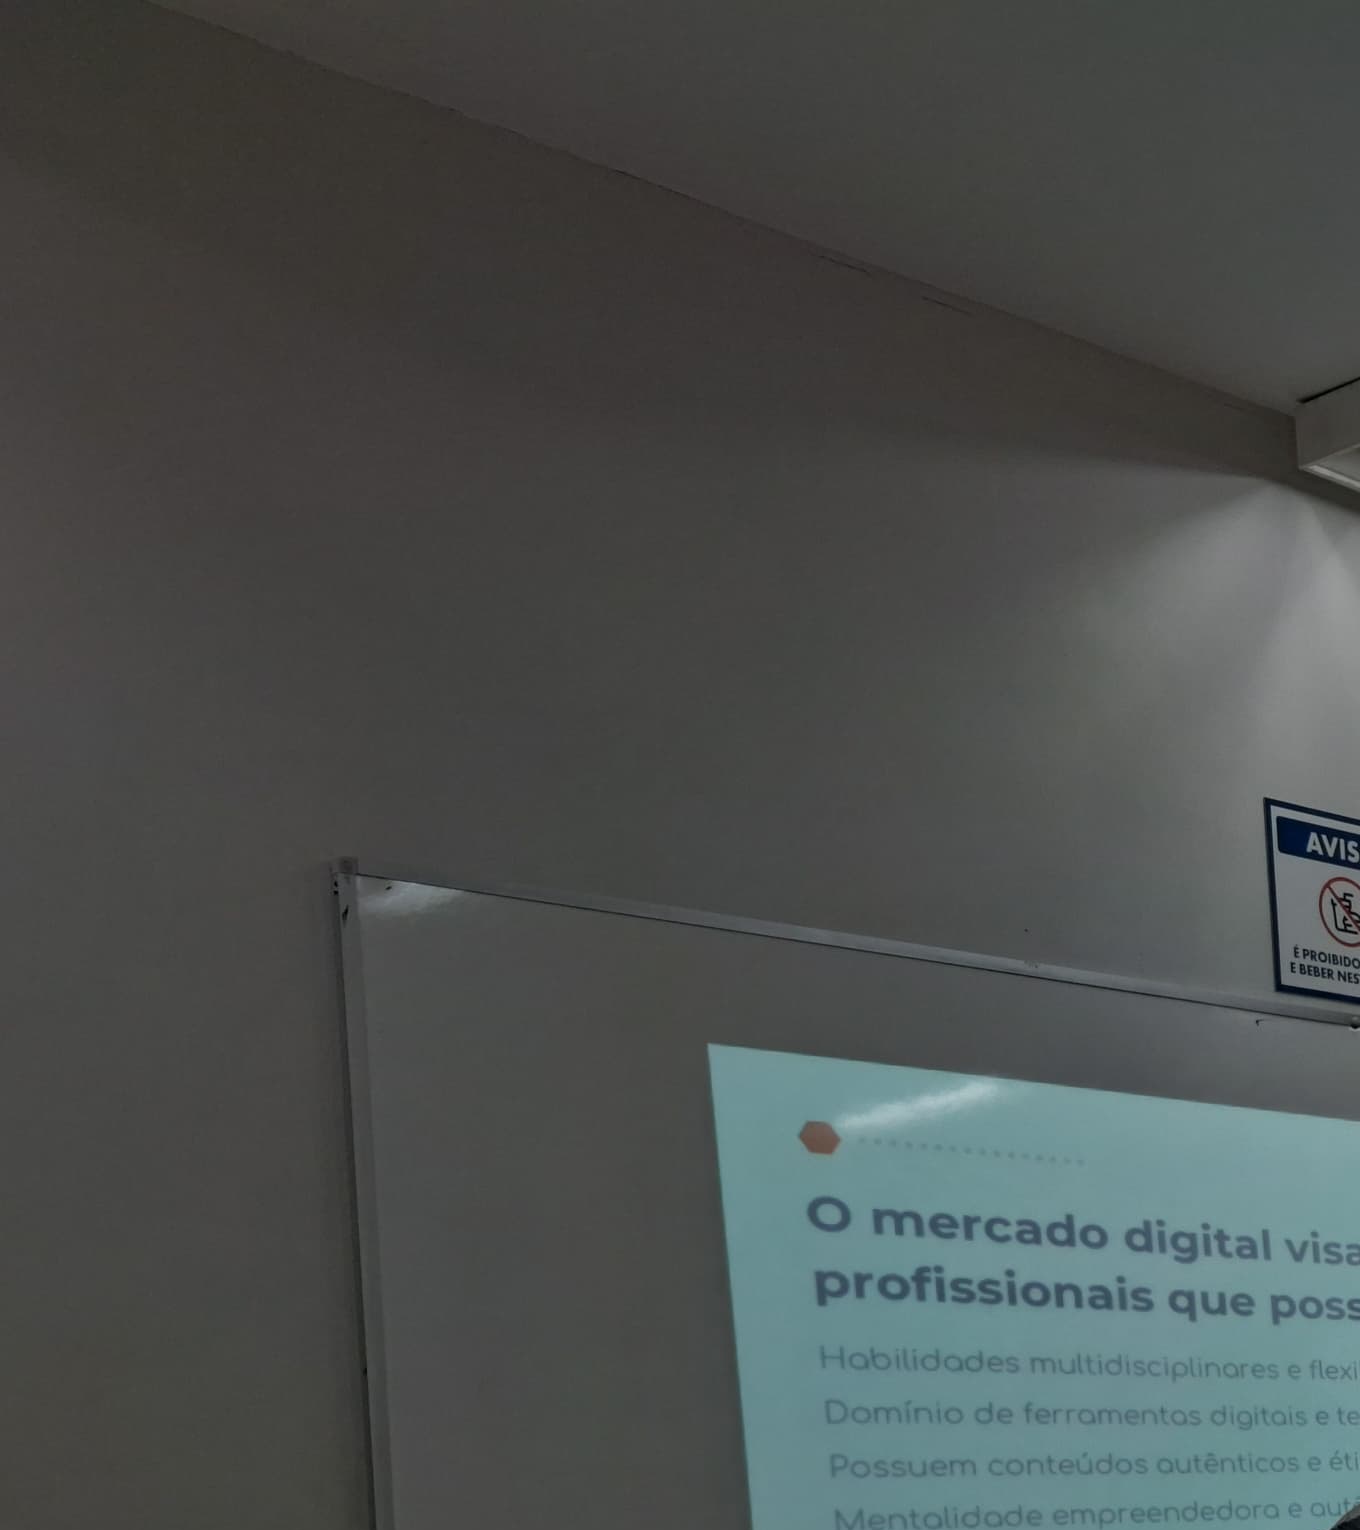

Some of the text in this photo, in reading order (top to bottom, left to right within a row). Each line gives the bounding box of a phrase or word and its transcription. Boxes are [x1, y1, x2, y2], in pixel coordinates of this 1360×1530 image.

[1290, 962, 1296, 973] E
[1299, 964, 1334, 980] BEBER
[1293, 944, 1300, 959] É
[1302, 949, 1360, 970] PROIBIDO
[807, 1195, 851, 1233] O
[872, 1208, 1109, 1250] mercado
[1124, 1219, 1272, 1264] digital
[814, 1265, 1155, 1312] profissionais
[1168, 1288, 1256, 1323] que
[819, 1345, 1020, 1374] Habilidades
[1030, 1353, 1280, 1383] multidisciplinares
[1287, 1362, 1302, 1380] e
[824, 1398, 965, 1425] Domínio
[973, 1401, 1013, 1425] de
[1024, 1401, 1202, 1426] ferramentas
[1210, 1405, 1308, 1431] digitais
[1315, 1410, 1329, 1426] e
[829, 1453, 977, 1479] Possuem
[988, 1452, 1149, 1476] conteúdos
[1156, 1452, 1300, 1475] autênticos
[1307, 1456, 1321, 1472] e
[1053, 1500, 1280, 1530] empreendedora
[1287, 1502, 1303, 1519] e
